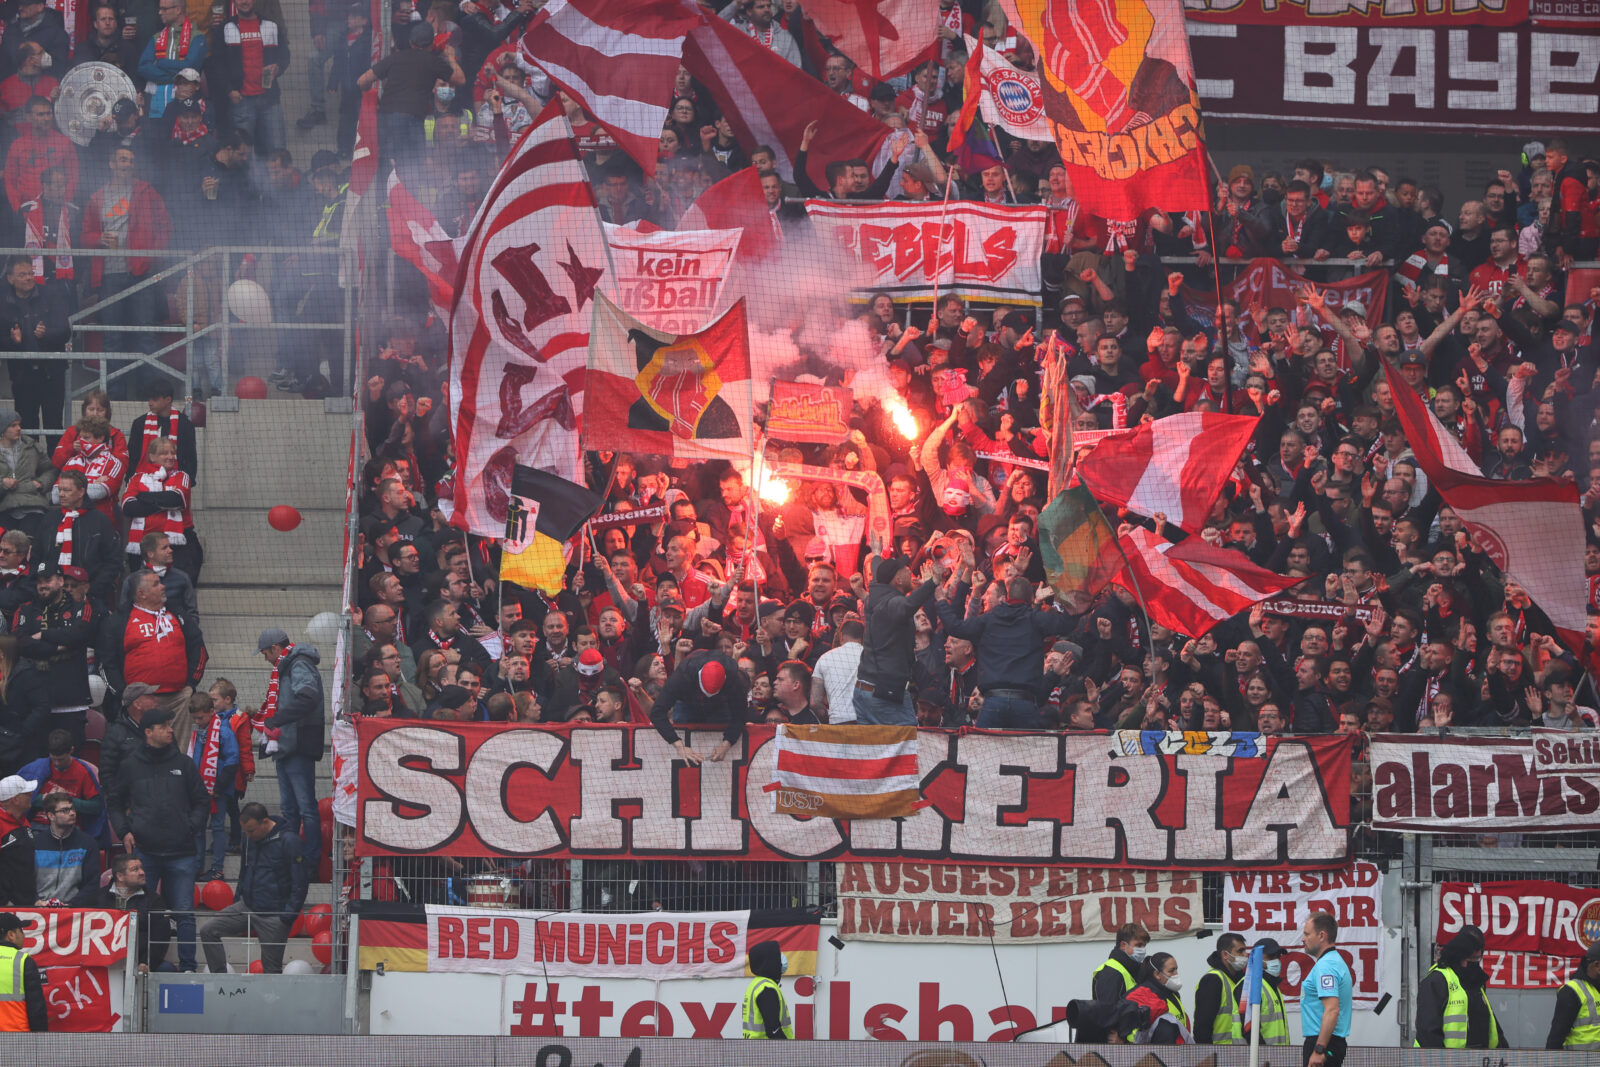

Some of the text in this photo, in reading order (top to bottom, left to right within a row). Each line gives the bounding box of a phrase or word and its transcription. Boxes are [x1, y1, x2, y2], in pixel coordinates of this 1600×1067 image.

[636, 250, 700, 277] kein
[363, 725, 1348, 864] SCHICKERIA
[779, 790, 824, 810] USP
[839, 862, 1198, 897] AUSGESPERRTE
[1231, 862, 1379, 894] WIR SIND
[840, 897, 1193, 938] IMMER BEI UNS
[1228, 900, 1298, 931] BEI
[437, 916, 519, 961] RED
